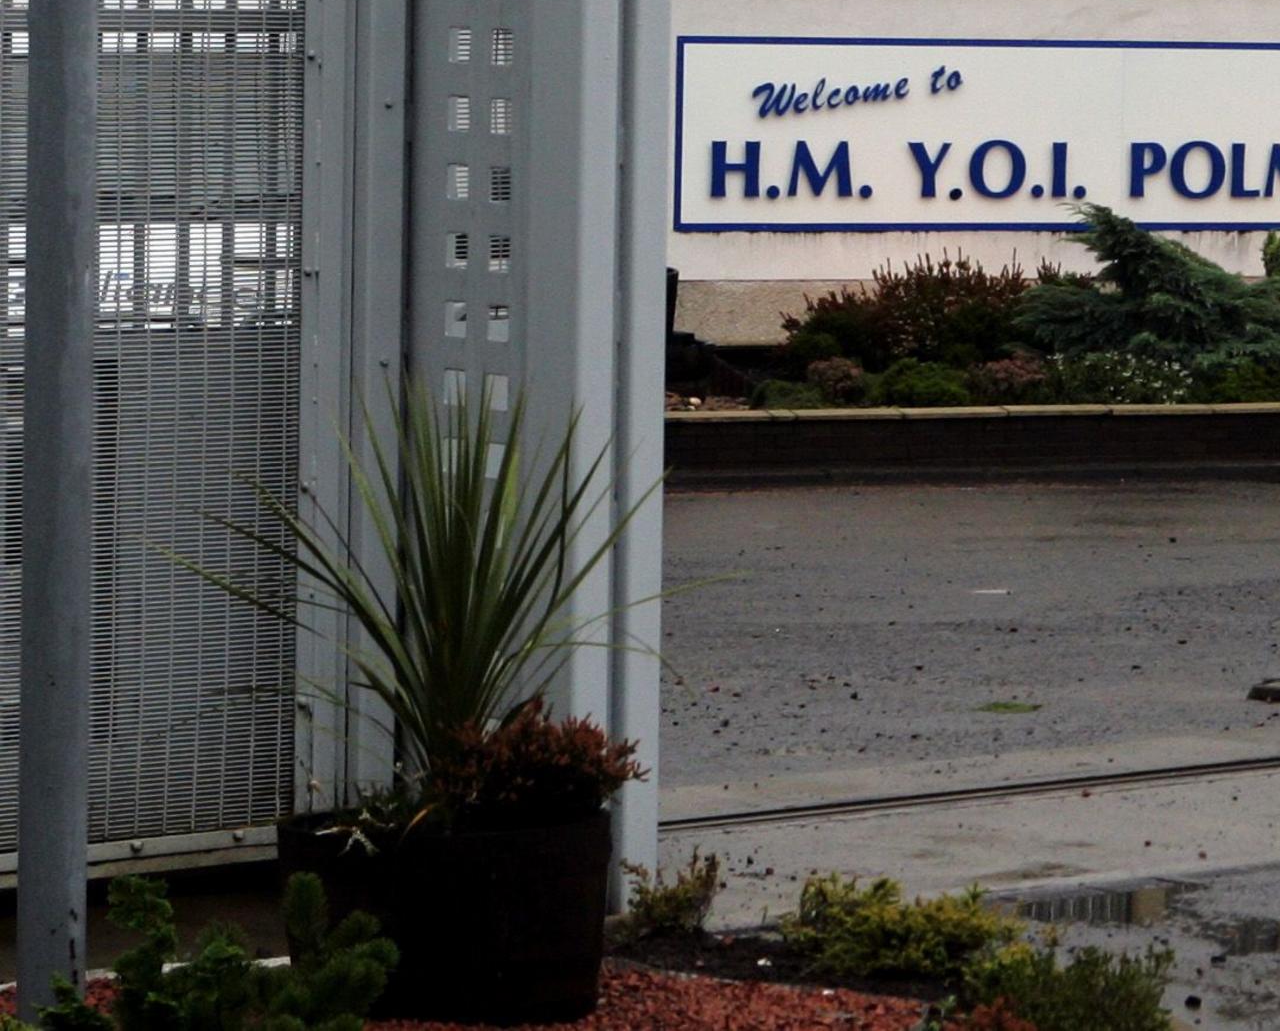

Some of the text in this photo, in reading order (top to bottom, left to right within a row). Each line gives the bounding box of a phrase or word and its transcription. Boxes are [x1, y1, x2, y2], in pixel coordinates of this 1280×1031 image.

[752, 66, 963, 119] Welcome to
[710, 140, 873, 199] H.M.
[908, 139, 1087, 201] Y.O.I.
